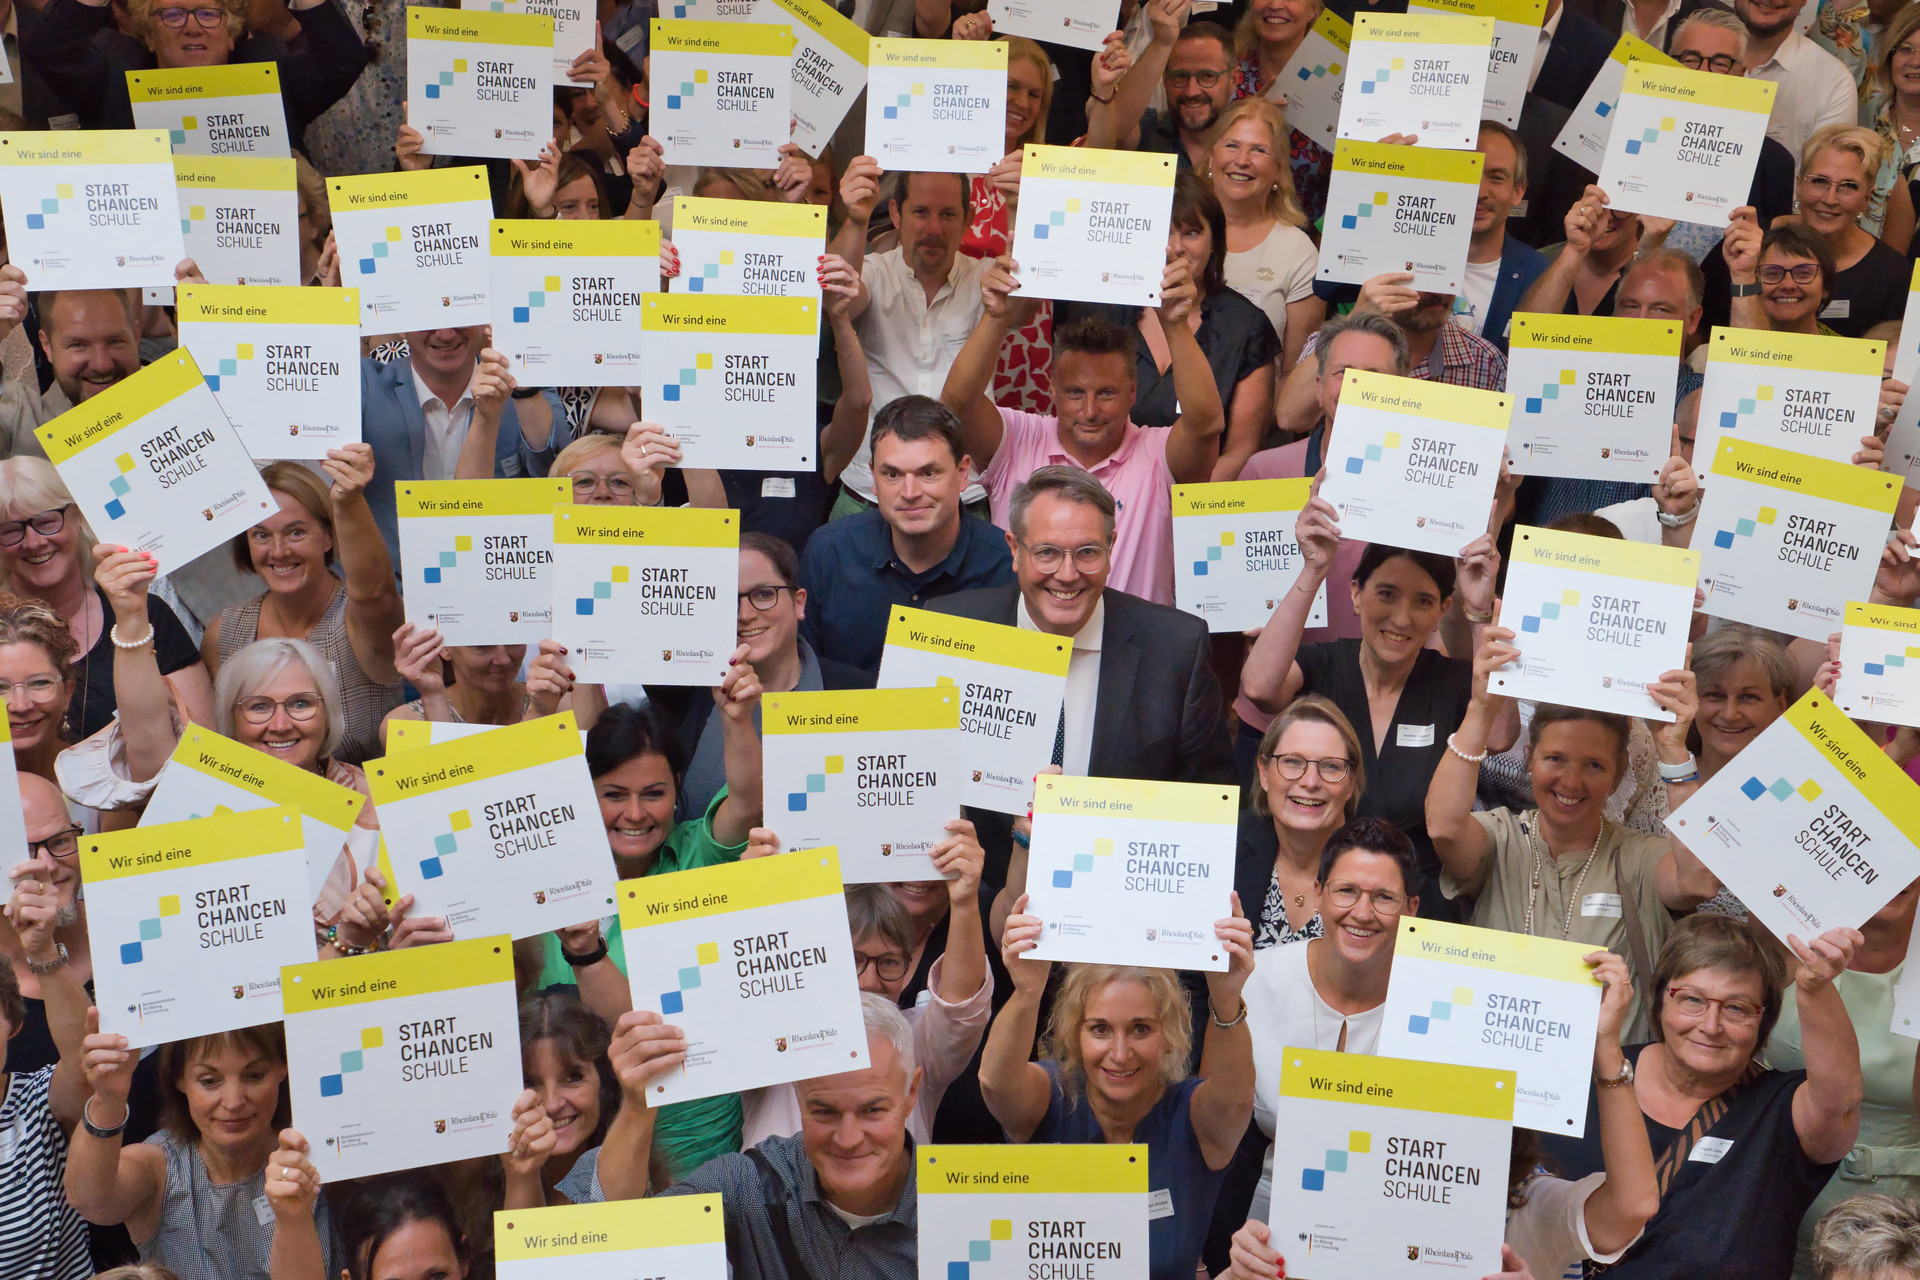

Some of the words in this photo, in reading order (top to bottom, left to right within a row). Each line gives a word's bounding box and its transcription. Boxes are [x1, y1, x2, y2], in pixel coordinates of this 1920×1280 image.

[716, 4, 752, 16] SCHULE
[424, 24, 440, 34] Wir
[441, 26, 459, 35] sind
[461, 27, 478, 37] eine
[476, 60, 514, 74] START
[801, 47, 834, 73] START
[1413, 59, 1450, 71] START
[476, 74, 535, 90] CHANCEN
[717, 71, 754, 84] START
[790, 67, 825, 98] SCHULE
[795, 57, 843, 96] CHANCEN
[1411, 71, 1469, 85] CHANCEN
[476, 88, 519, 102] SCHULE
[717, 85, 774, 99] CHANCEN
[933, 83, 969, 95] START
[1409, 83, 1451, 96] SCHULE
[716, 98, 758, 112] SCHULE
[933, 96, 989, 109] CHANCEN
[206, 113, 244, 127] START
[932, 108, 973, 121] SCHULE
[208, 125, 270, 140] CHANCEN
[1683, 121, 1724, 138] START
[211, 139, 255, 154] SCHULE
[1680, 135, 1743, 156] CHANCEN
[1676, 148, 1722, 167] SCHULE
[84, 183, 129, 197] START
[86, 197, 158, 211] CHANCEN
[1090, 200, 1130, 215] START
[1397, 194, 1436, 209] START
[88, 212, 140, 226] SCHULE
[215, 207, 256, 220] START
[1395, 208, 1456, 225] CHANCEN
[216, 221, 280, 235] CHANCEN
[411, 222, 452, 238] START
[1088, 214, 1151, 231] CHANCEN
[1392, 221, 1437, 237] SCHULE
[216, 235, 262, 249] SCHULE
[413, 235, 479, 253] CHANCEN
[1086, 229, 1132, 244] SCHULE
[415, 251, 463, 268] SCHULE
[743, 252, 784, 267] START
[571, 277, 615, 290] START
[743, 267, 805, 283] CHANCEN
[742, 281, 787, 296] SCHULE
[572, 292, 640, 306] CHANCEN
[572, 308, 621, 322] SCHULE
[1531, 332, 1549, 342] Wir
[1550, 333, 1570, 343] sind
[1572, 334, 1593, 345] eine
[265, 344, 312, 359] START
[266, 361, 339, 376] CHANCEN
[724, 354, 769, 369] START
[266, 377, 319, 392] SCHULE
[724, 370, 795, 387] CHANCEN
[1586, 372, 1631, 387] START
[724, 387, 775, 402] SCHULE
[1585, 387, 1655, 404] CHANCEN
[1784, 388, 1831, 405] START
[1584, 402, 1634, 418] SCHULE
[1782, 403, 1855, 423] CHANCEN
[64, 433, 83, 447] Wir
[83, 420, 103, 438] sind
[103, 411, 123, 427] eine
[1780, 419, 1833, 437] SCHULE
[140, 425, 181, 458] START
[1411, 437, 1457, 456] START
[149, 428, 215, 473] CHANCEN
[158, 453, 207, 489] SCHULE
[1408, 452, 1478, 476] CHANCEN
[1404, 468, 1456, 489] SCHULE
[576, 525, 595, 536] Wir
[598, 526, 619, 537] sind
[622, 527, 644, 538] eine
[1787, 514, 1837, 537] START
[483, 535, 528, 549] START
[1244, 529, 1283, 544] START
[1782, 530, 1859, 561] CHANCEN
[1245, 557, 1290, 572] SCHULE
[1777, 546, 1834, 572] SCHULE
[485, 566, 536, 581] SCHULE
[641, 567, 689, 582] START
[641, 584, 716, 600] CHANCEN
[640, 601, 694, 616] SCHULE
[1591, 594, 1641, 614] START
[1589, 610, 1666, 635] CHANCEN
[1869, 616, 1890, 625] Wir
[1893, 620, 1917, 629] sind
[1586, 626, 1642, 648] SCHULE
[964, 683, 1013, 704] START
[962, 699, 1036, 727] CHANCEN
[958, 717, 1013, 740] SCHULE
[1808, 720, 1827, 740] Wir
[1824, 739, 1849, 761] sind
[1844, 759, 1866, 780] eine
[199, 752, 218, 768] Wir
[218, 763, 243, 778] sind
[242, 773, 265, 788] eine
[856, 754, 907, 771] START
[857, 771, 936, 789] CHANCEN
[483, 793, 536, 821] START
[857, 790, 914, 807] SCHULE
[488, 804, 575, 840] CHANCEN
[1823, 804, 1871, 847] START
[493, 829, 557, 859] SCHULE
[1127, 841, 1180, 858] START
[1809, 817, 1879, 885] CHANCEN
[1794, 830, 1847, 881] SCHULE
[1126, 858, 1209, 878] CHANCEN
[1124, 876, 1185, 894] SCHULE
[194, 884, 250, 909] START
[197, 898, 286, 929] CHANCEN
[199, 922, 264, 949] SCHULE
[733, 931, 789, 957] START
[736, 946, 826, 978] CHANCEN
[739, 971, 804, 999] SCHULE
[1486, 993, 1542, 1015] START
[398, 1016, 457, 1041] START
[1484, 1011, 1570, 1039] CHANCEN
[400, 1031, 493, 1062] CHANCEN
[1481, 1028, 1544, 1053] SCHULE
[402, 1055, 468, 1082] SCHULE
[1309, 1076, 1333, 1090] Wir
[1335, 1080, 1363, 1094] sind
[1366, 1083, 1393, 1098] eine
[1386, 1136, 1447, 1160] START
[945, 1171, 969, 1184] Wir
[972, 1171, 999, 1184] sind
[1002, 1171, 1029, 1184] eine
[1385, 1158, 1480, 1186] CHANCEN
[1383, 1179, 1452, 1204] SCHULE
[1027, 1220, 1086, 1239] START
[523, 1235, 547, 1249] Wir
[551, 1232, 578, 1247] sind
[581, 1230, 608, 1244] eine
[1028, 1241, 1121, 1259] CHANCEN
[1028, 1262, 1095, 1280] SCHULE
